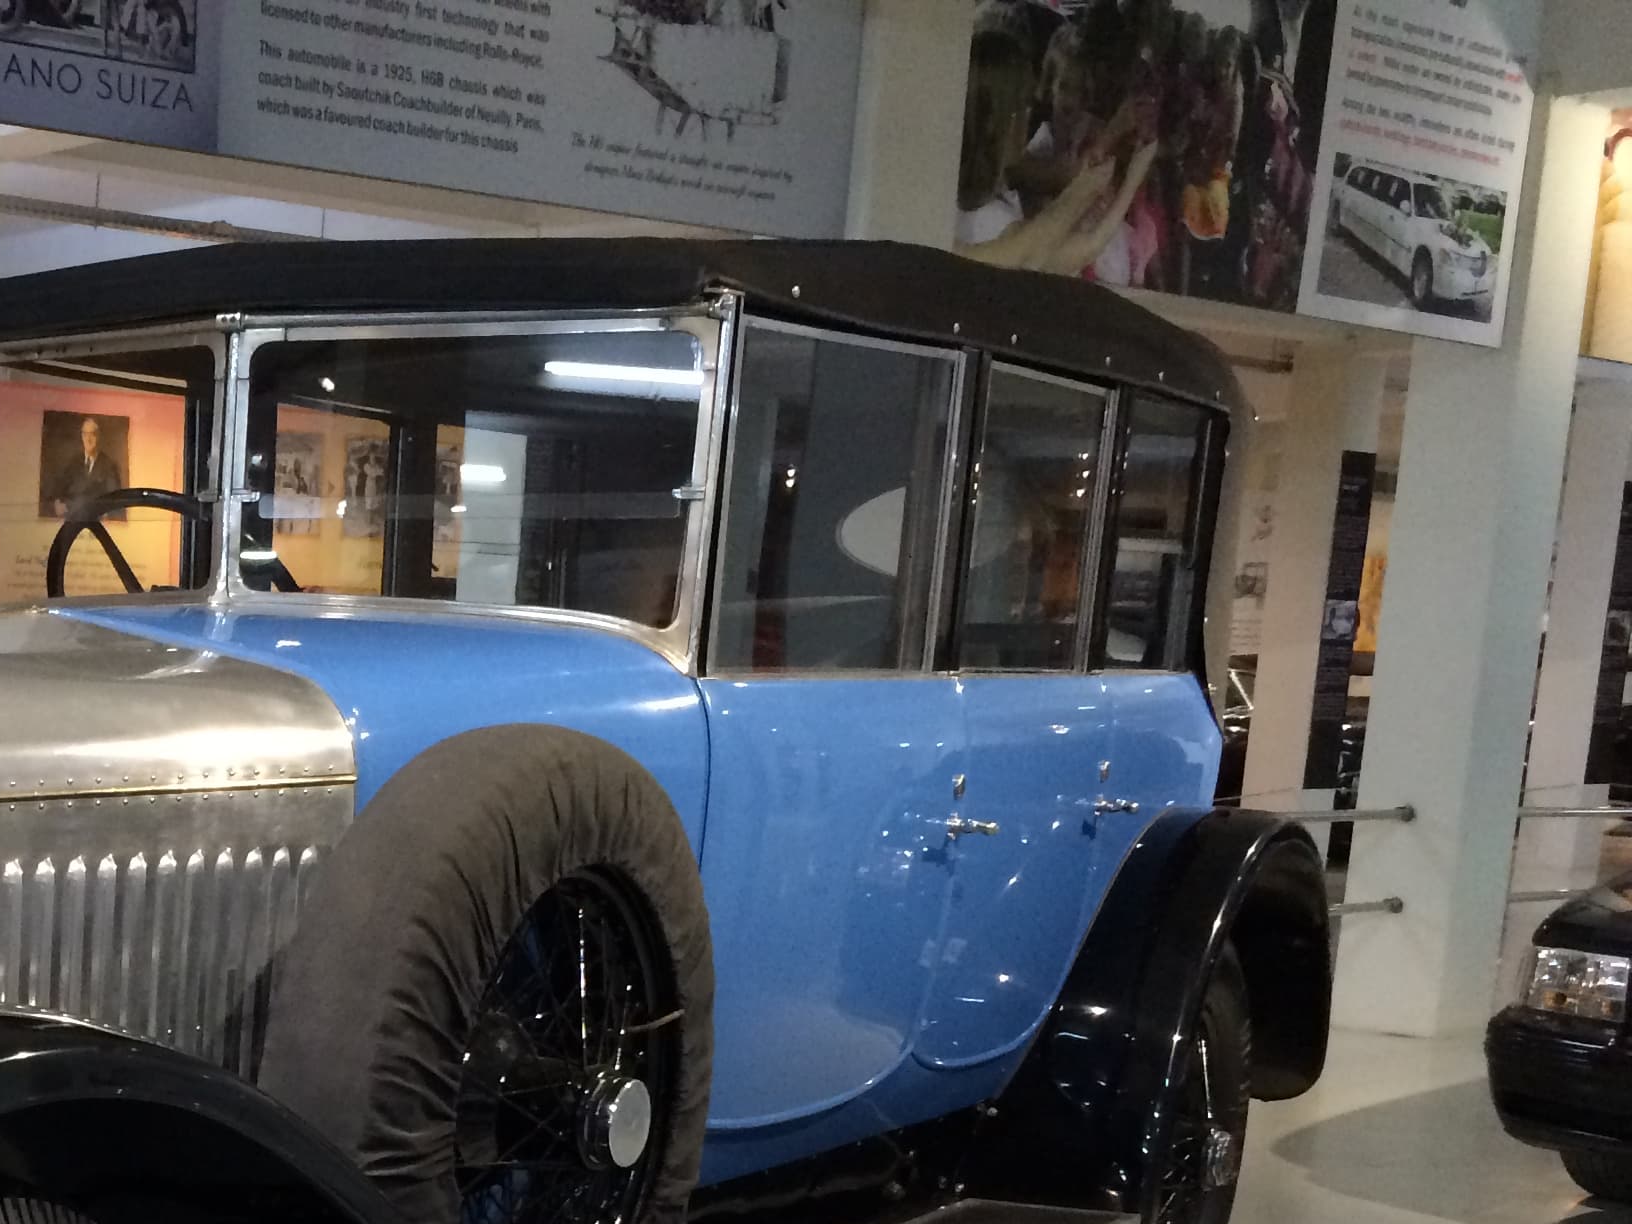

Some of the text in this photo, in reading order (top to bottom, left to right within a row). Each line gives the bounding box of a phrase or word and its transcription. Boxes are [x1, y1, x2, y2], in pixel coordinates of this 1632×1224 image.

[261, 1, 309, 24] licensed
[310, 10, 321, 26] to
[323, 14, 352, 31] other
[354, 21, 432, 46] manufacturers
[434, 32, 482, 59] including
[442, 8, 499, 35] technology
[96, 68, 193, 113] SUIZA
[259, 39, 283, 58] This
[288, 47, 352, 72] automobile
[356, 58, 366, 73] is
[371, 64, 379, 76] a
[449, 76, 487, 96] chassis
[257, 97, 290, 116] which
[292, 106, 314, 120] was
[323, 106, 372, 130] favoured
[373, 118, 405, 134] coach
[258, 71, 292, 89] coach
[295, 75, 320, 94] built
[323, 80, 335, 99] by
[465, 104, 476, 120] of
